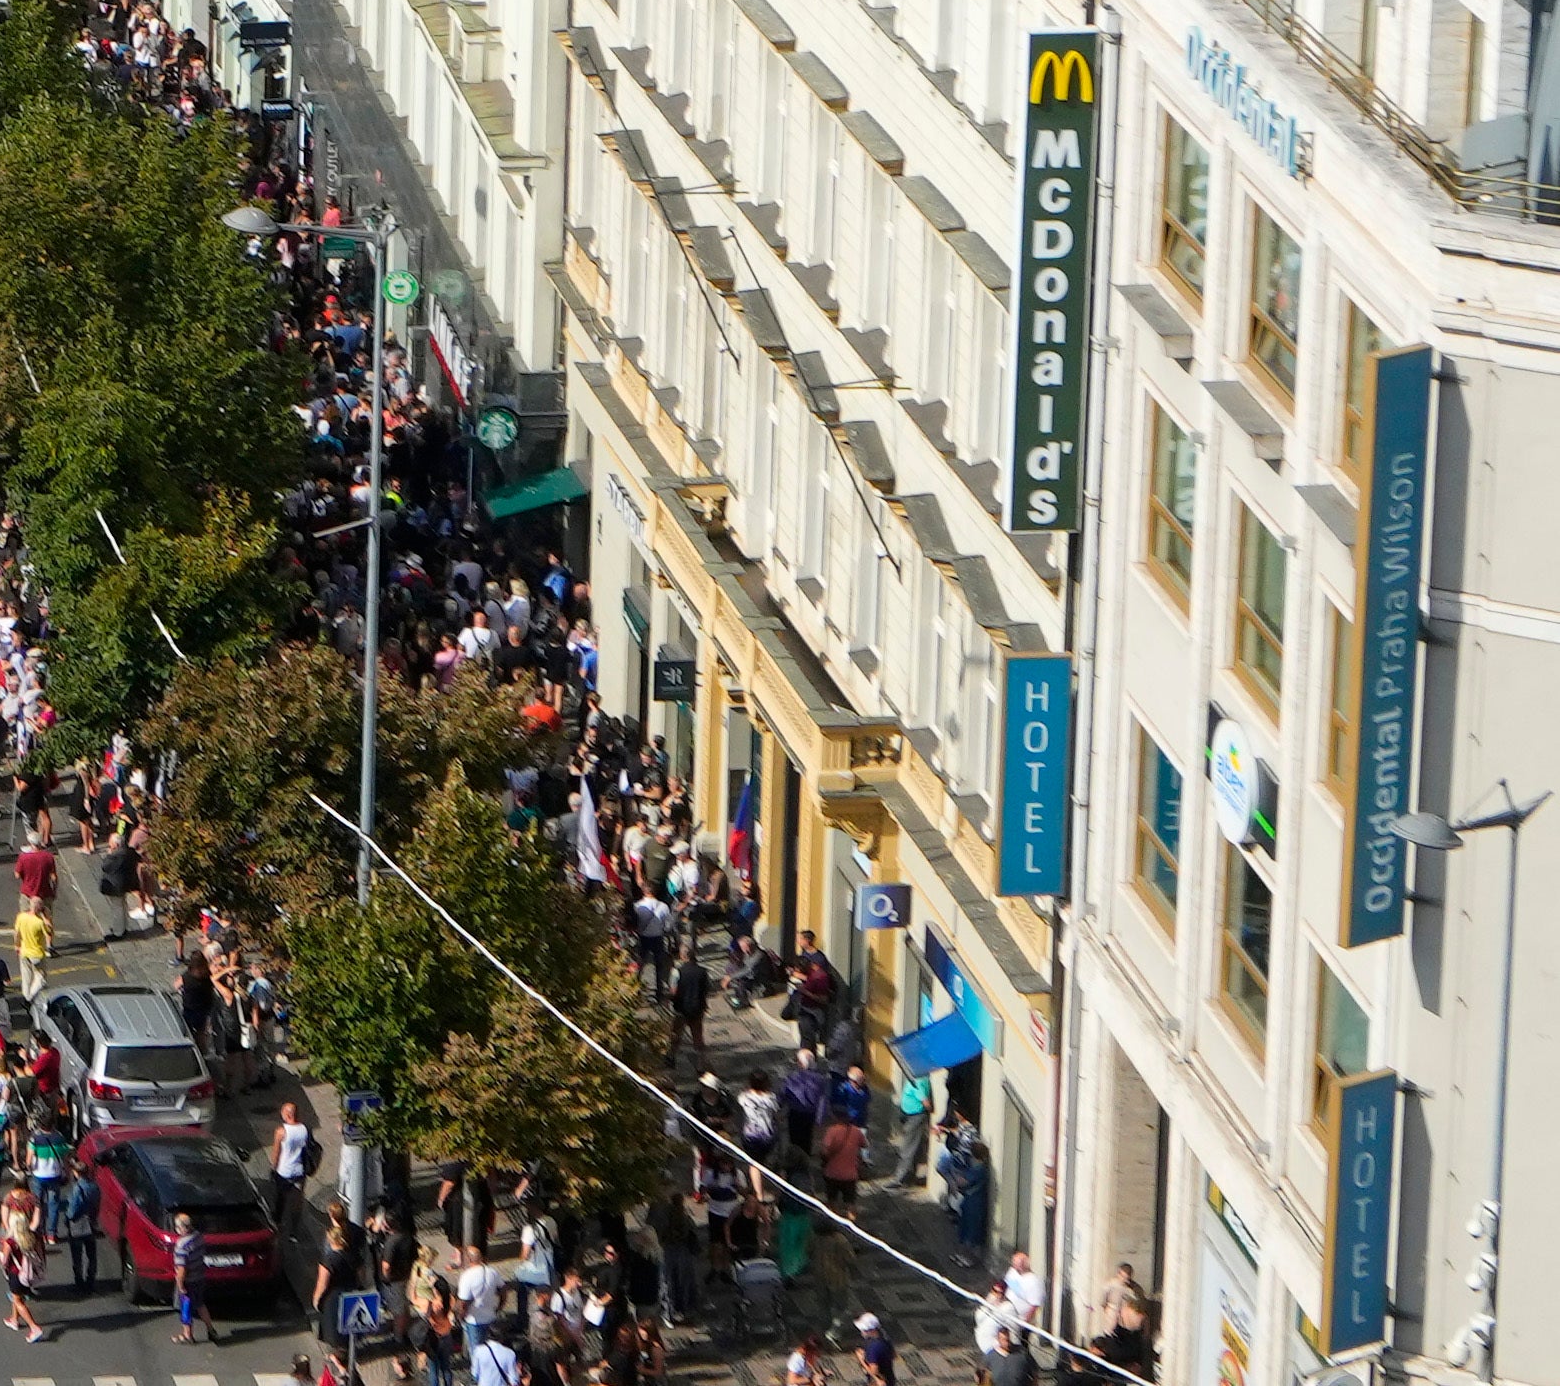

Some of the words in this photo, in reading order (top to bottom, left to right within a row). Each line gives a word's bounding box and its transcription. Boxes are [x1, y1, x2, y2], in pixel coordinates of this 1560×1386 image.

[1026, 128, 1082, 526] McDonald's
[1382, 451, 1416, 580] Wilson
[1373, 585, 1410, 693] Praha
[1021, 681, 1051, 875] HOTEL
[1363, 700, 1406, 916] Occidental
[1348, 1104, 1379, 1325] HOTEL
